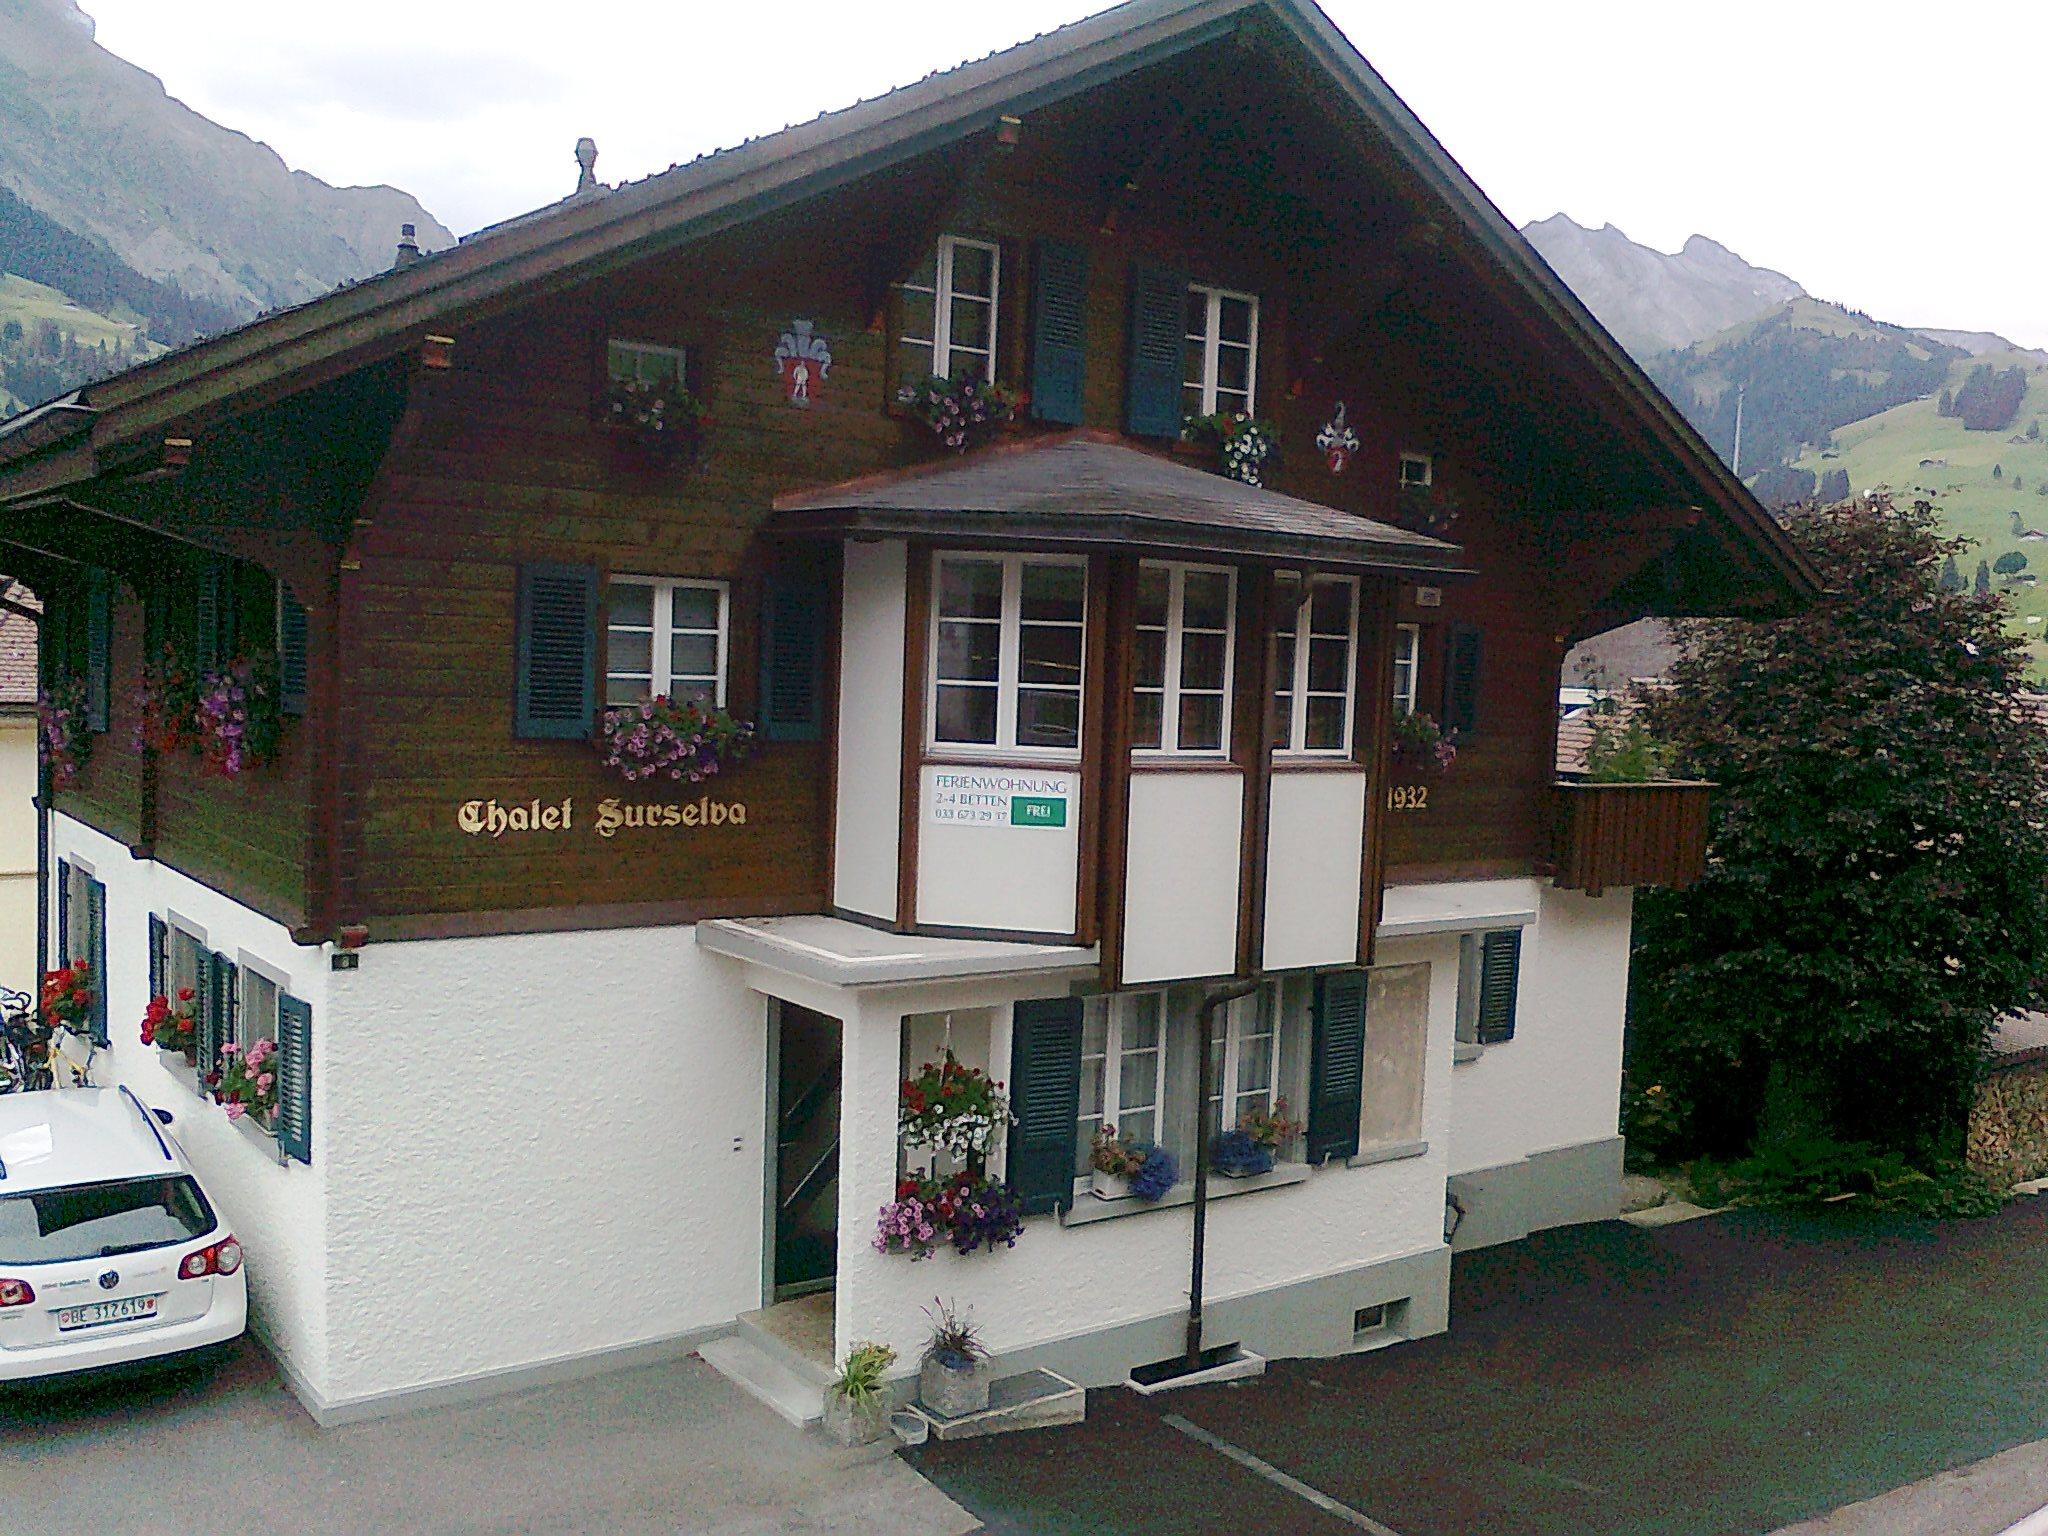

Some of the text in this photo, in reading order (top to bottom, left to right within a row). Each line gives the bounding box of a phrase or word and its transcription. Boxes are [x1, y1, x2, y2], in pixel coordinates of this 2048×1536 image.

[936, 775, 1067, 793] FERIENWOHNUNG
[936, 792, 1007, 806] 2-4 BETTEN
[1387, 785, 1428, 811] 1932
[457, 796, 747, 837] Chalet Surselva
[1026, 804, 1051, 818] FREI
[71, 1298, 146, 1324] BE 312619
